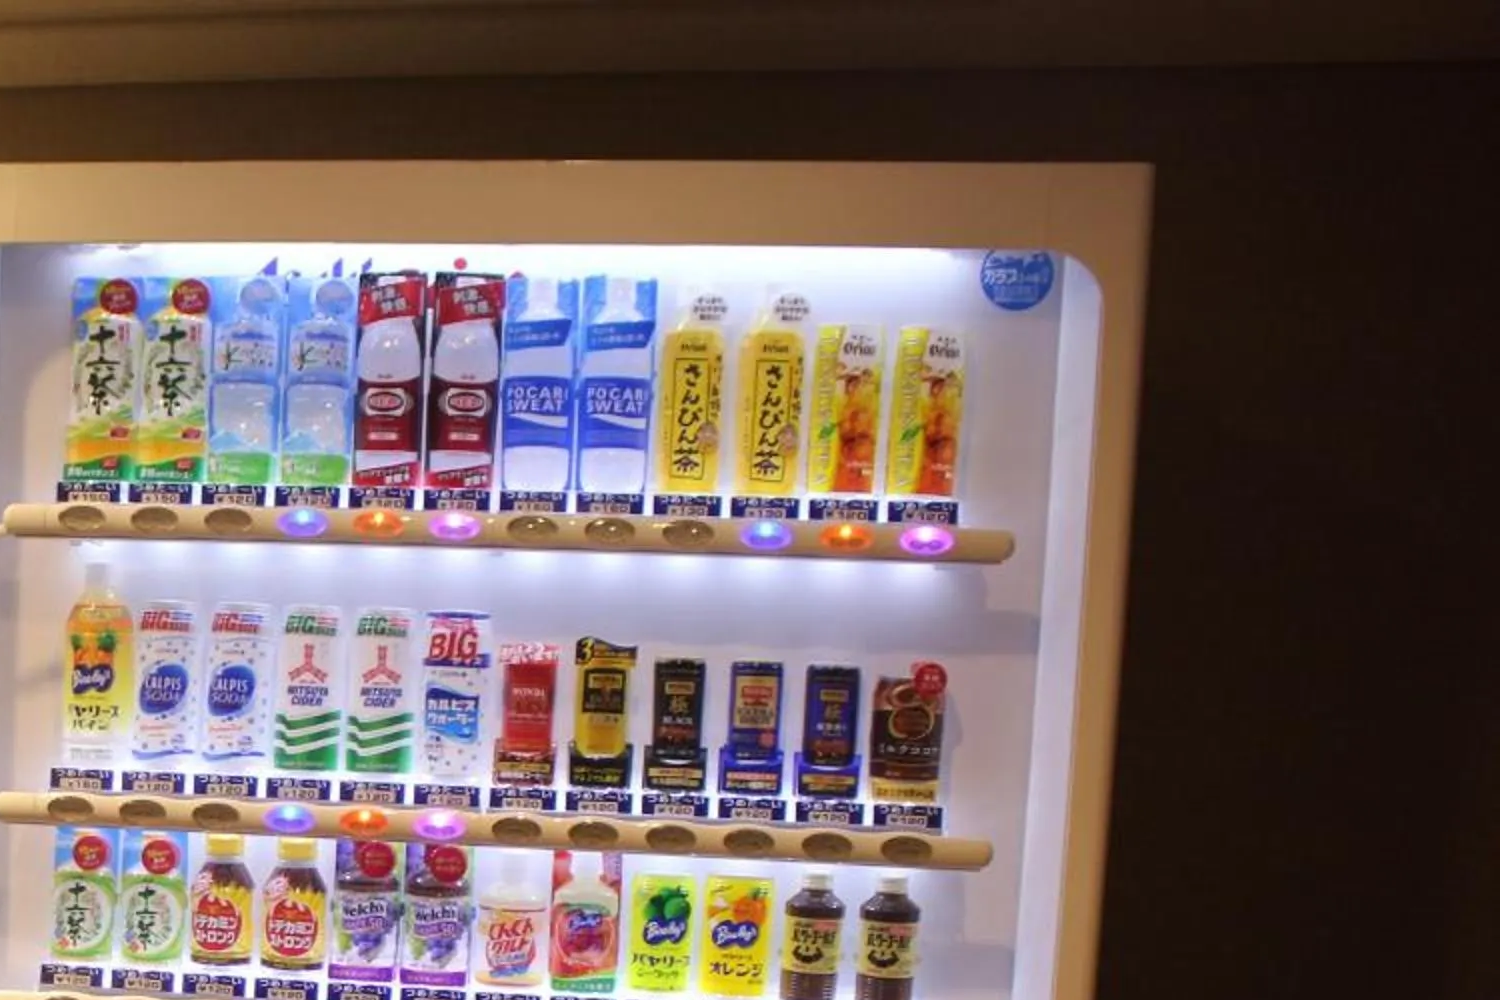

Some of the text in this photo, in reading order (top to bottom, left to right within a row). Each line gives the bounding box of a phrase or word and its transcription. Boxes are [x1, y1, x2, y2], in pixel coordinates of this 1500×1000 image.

[85, 325, 121, 415] 十六茶
[156, 325, 192, 416] 十六茶
[506, 386, 568, 400] POCARI
[586, 387, 648, 400] POCARI
[507, 399, 563, 413] SWEAT
[587, 400, 644, 413] SWEAT
[429, 627, 478, 660] BIG
[578, 638, 594, 662] 3
[145, 676, 182, 690] CALPIS
[211, 677, 248, 691] CALPIS
[143, 690, 180, 702] SODA
[211, 691, 247, 704] SODA
[290, 695, 323, 706] CIDER
[364, 697, 395, 708] CIDER
[65, 882, 90, 947] 十六茶
[136, 886, 159, 950] 十六茶
[710, 962, 763, 978] オレンジ
